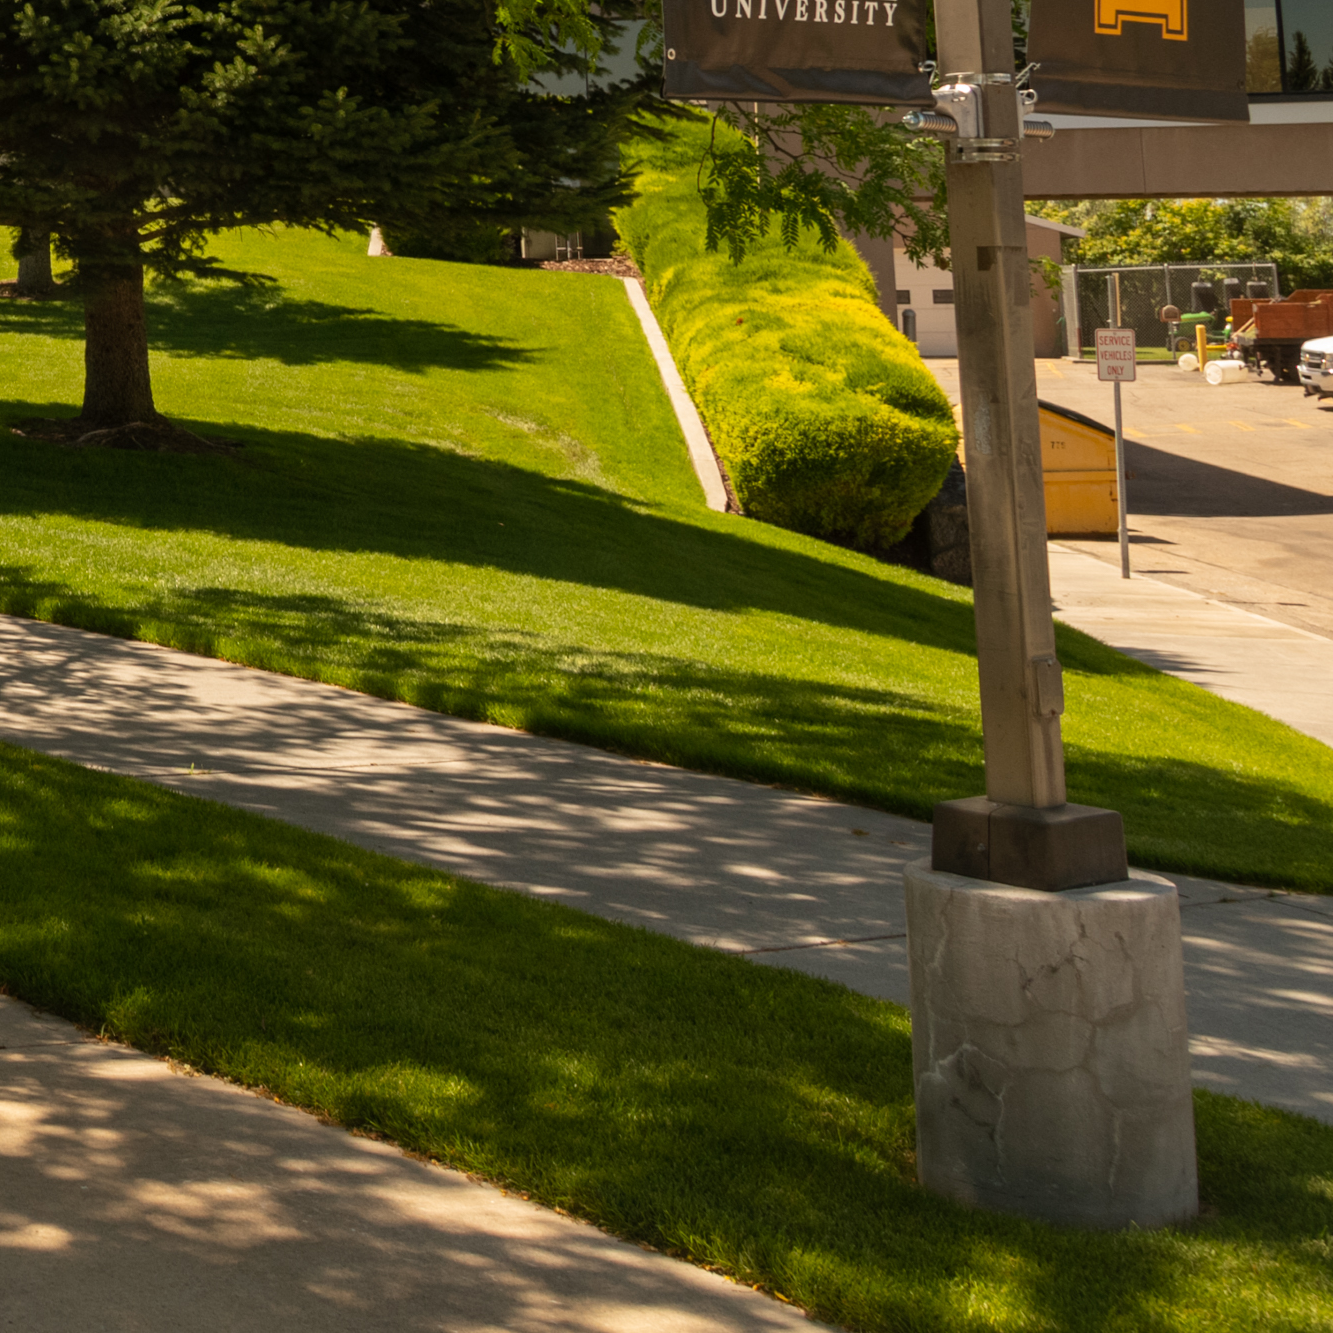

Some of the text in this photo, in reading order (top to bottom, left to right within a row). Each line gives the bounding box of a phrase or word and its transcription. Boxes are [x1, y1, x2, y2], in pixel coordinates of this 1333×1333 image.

[1099, 335, 1131, 346] SERVICE
[1100, 350, 1132, 361] VEHICLES
[1107, 365, 1124, 376] ONLY
